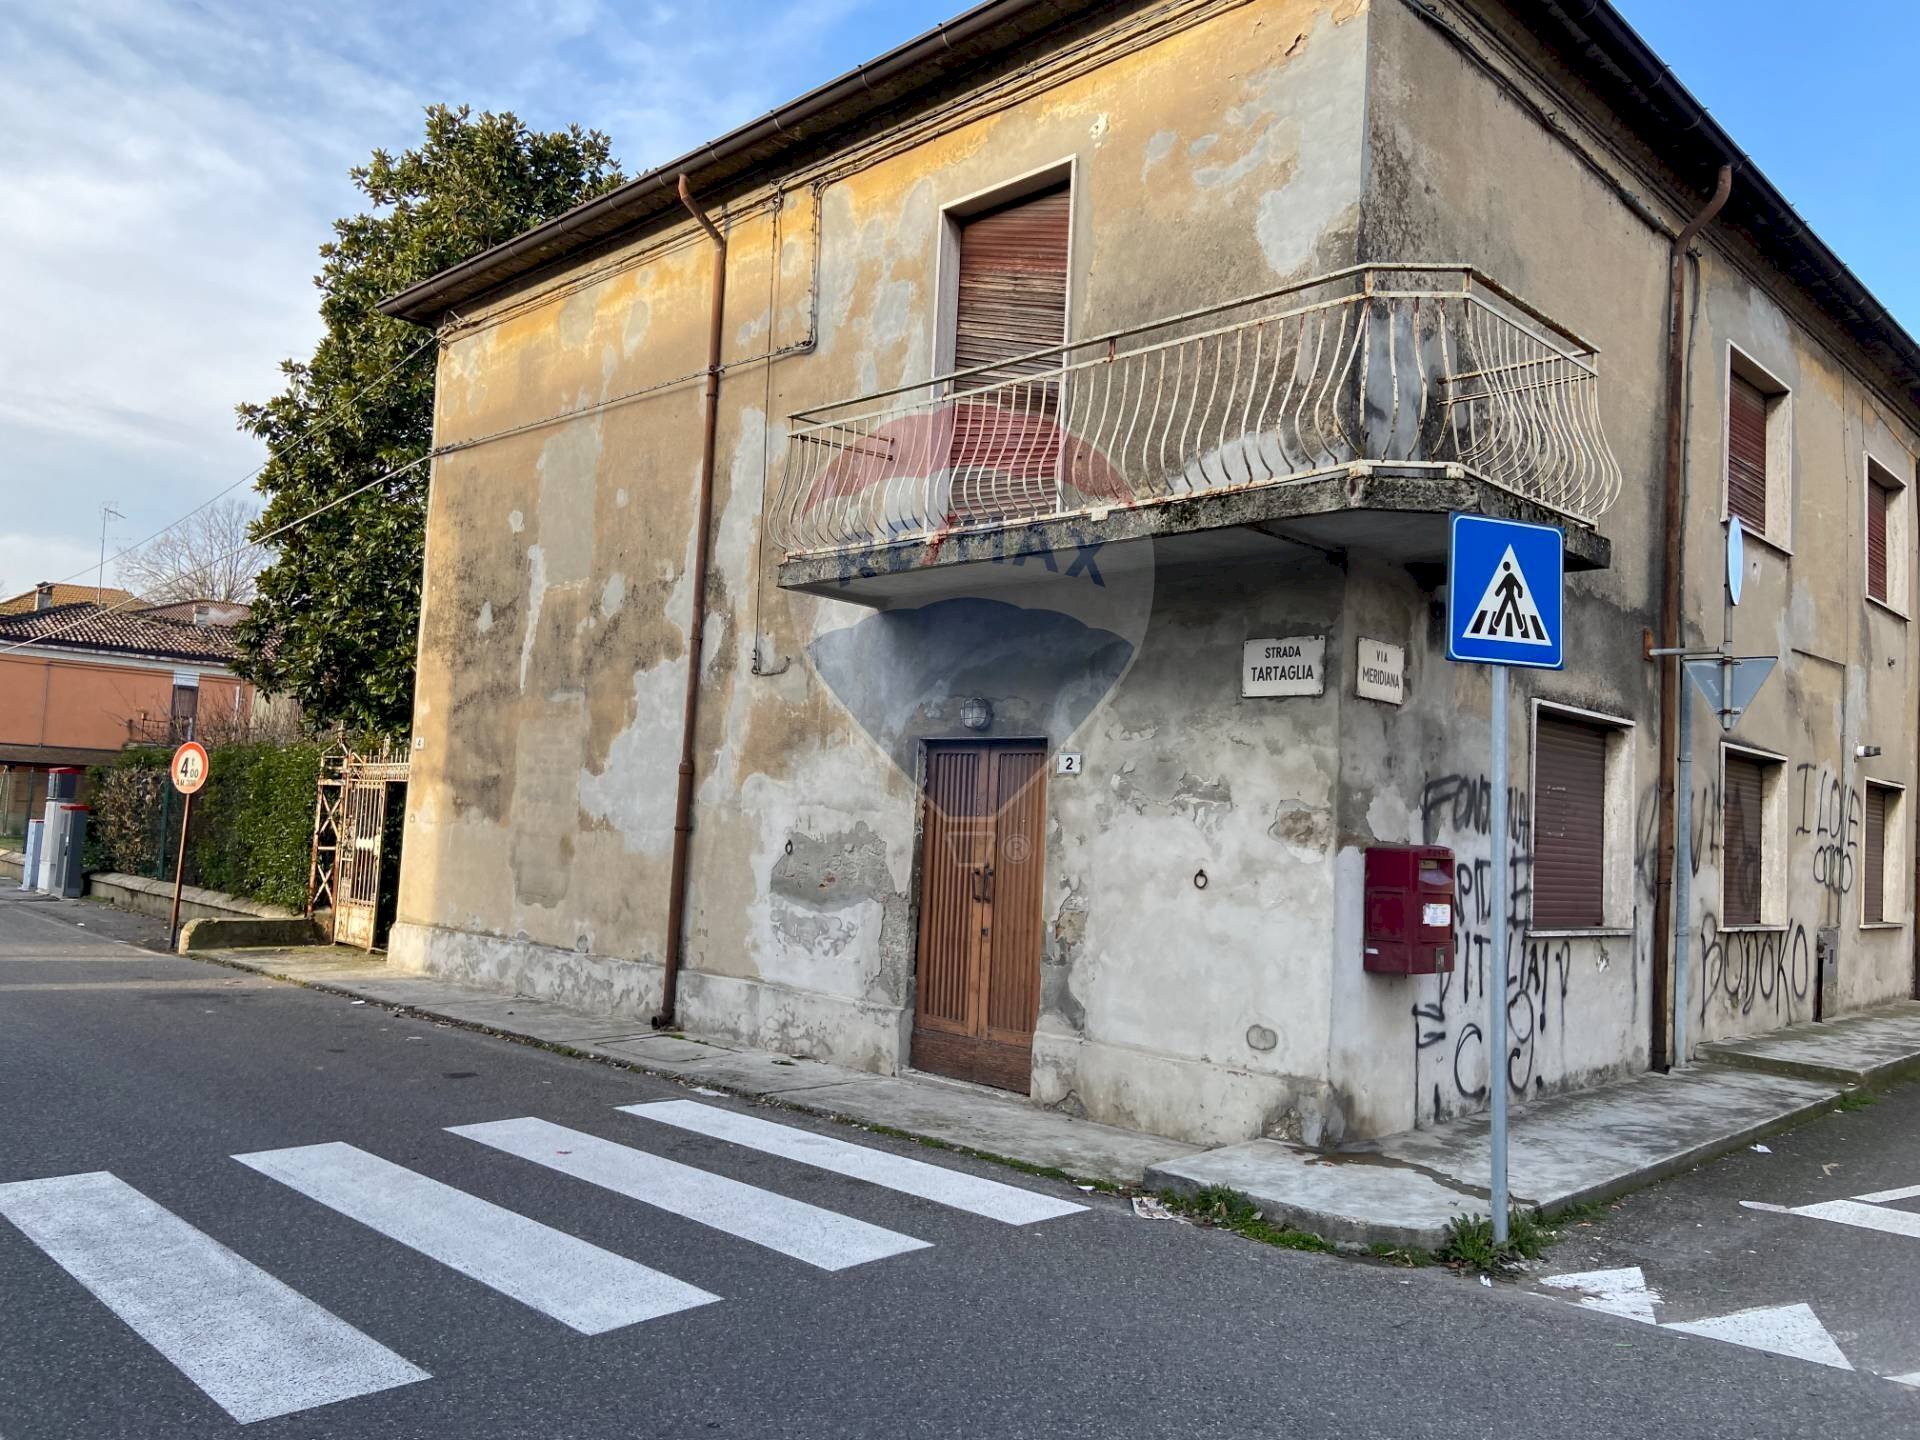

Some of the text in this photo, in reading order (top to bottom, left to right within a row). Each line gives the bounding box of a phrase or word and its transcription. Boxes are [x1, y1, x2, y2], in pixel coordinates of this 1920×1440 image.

[1265, 646, 1301, 658] STRADA
[1376, 649, 1388, 664] VIA
[1251, 664, 1314, 682] TARTAGLIA
[1362, 666, 1400, 689] MERIDIANA
[1065, 757, 1074, 770] 2
[1796, 763, 1816, 836] I
[1817, 770, 1863, 848] LOVE
